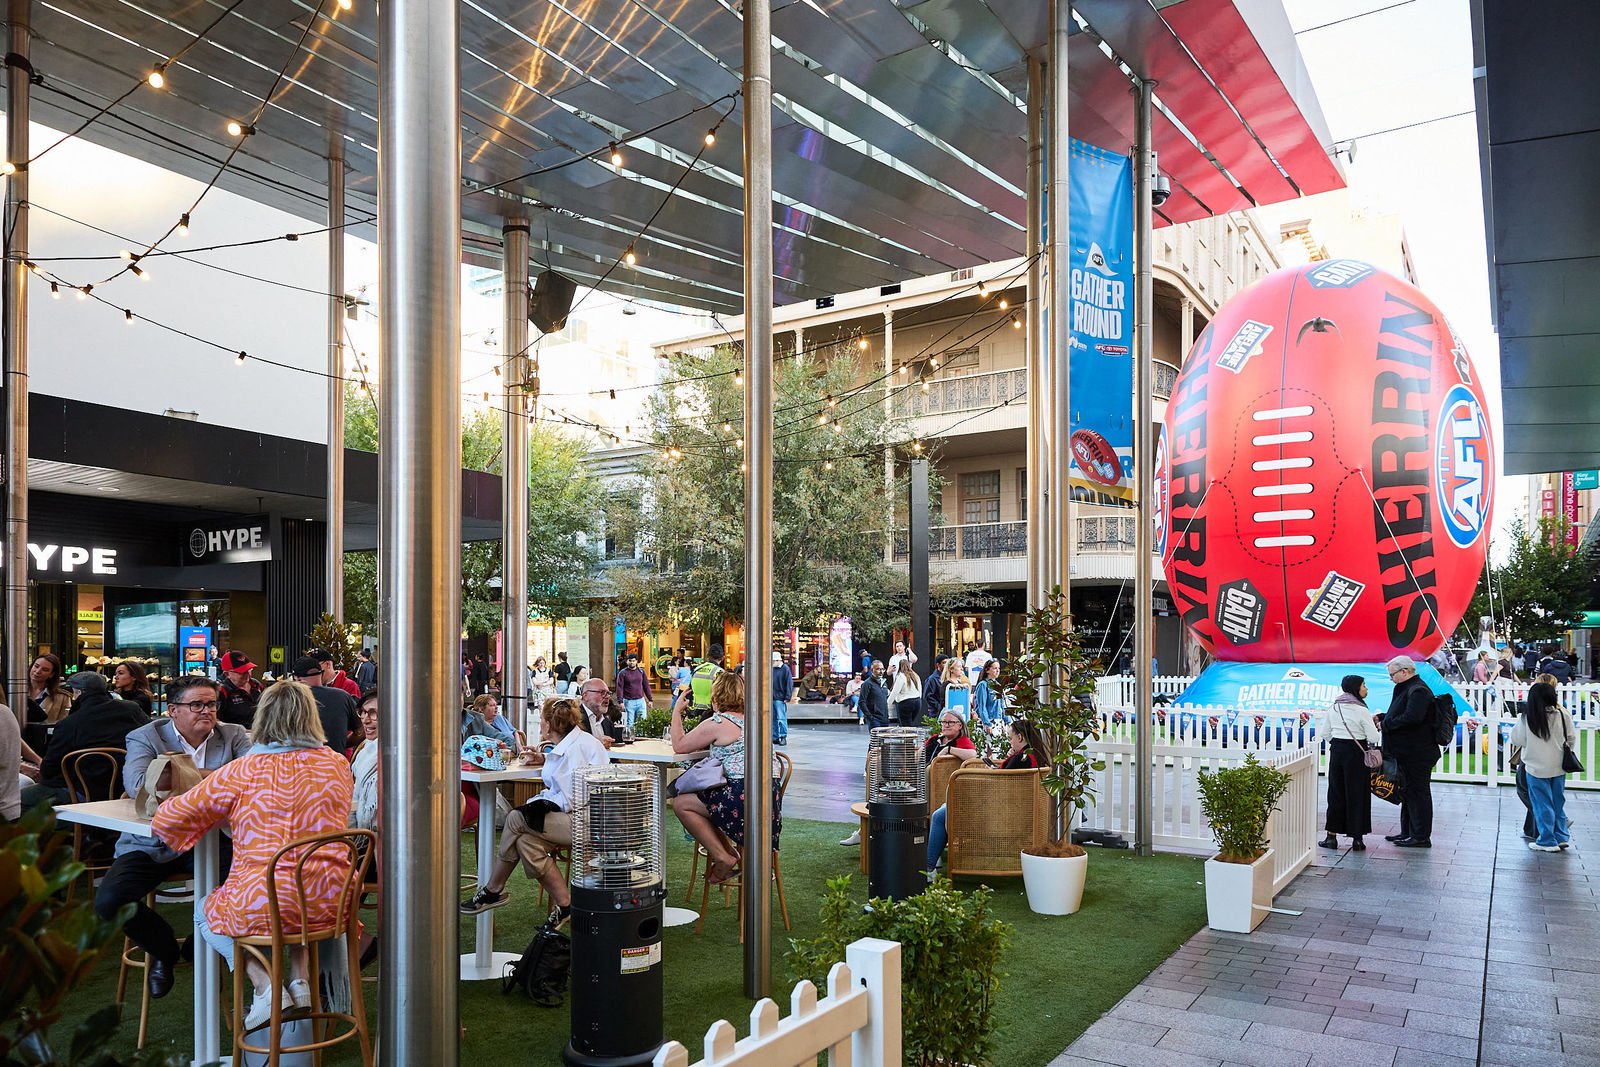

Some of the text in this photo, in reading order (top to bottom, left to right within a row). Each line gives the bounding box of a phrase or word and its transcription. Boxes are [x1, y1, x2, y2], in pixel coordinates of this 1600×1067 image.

[1071, 268, 1125, 310] GATHER
[1313, 260, 1370, 285] GATH
[1073, 300, 1122, 340] ROUND
[1220, 322, 1255, 363] OVAL
[1226, 324, 1264, 369] ADELAIDE
[1171, 323, 1214, 645] SHERRIN
[1371, 291, 1438, 649] SHERRIN
[1451, 400, 1483, 532] AFL
[0, 541, 118, 575] YPE
[208, 526, 263, 552] HYPE
[1223, 587, 1256, 640] GATH
[1312, 578, 1350, 624] ADELAIDE
[1324, 586, 1360, 627] OVAL
[1238, 682, 1296, 703] GATHER
